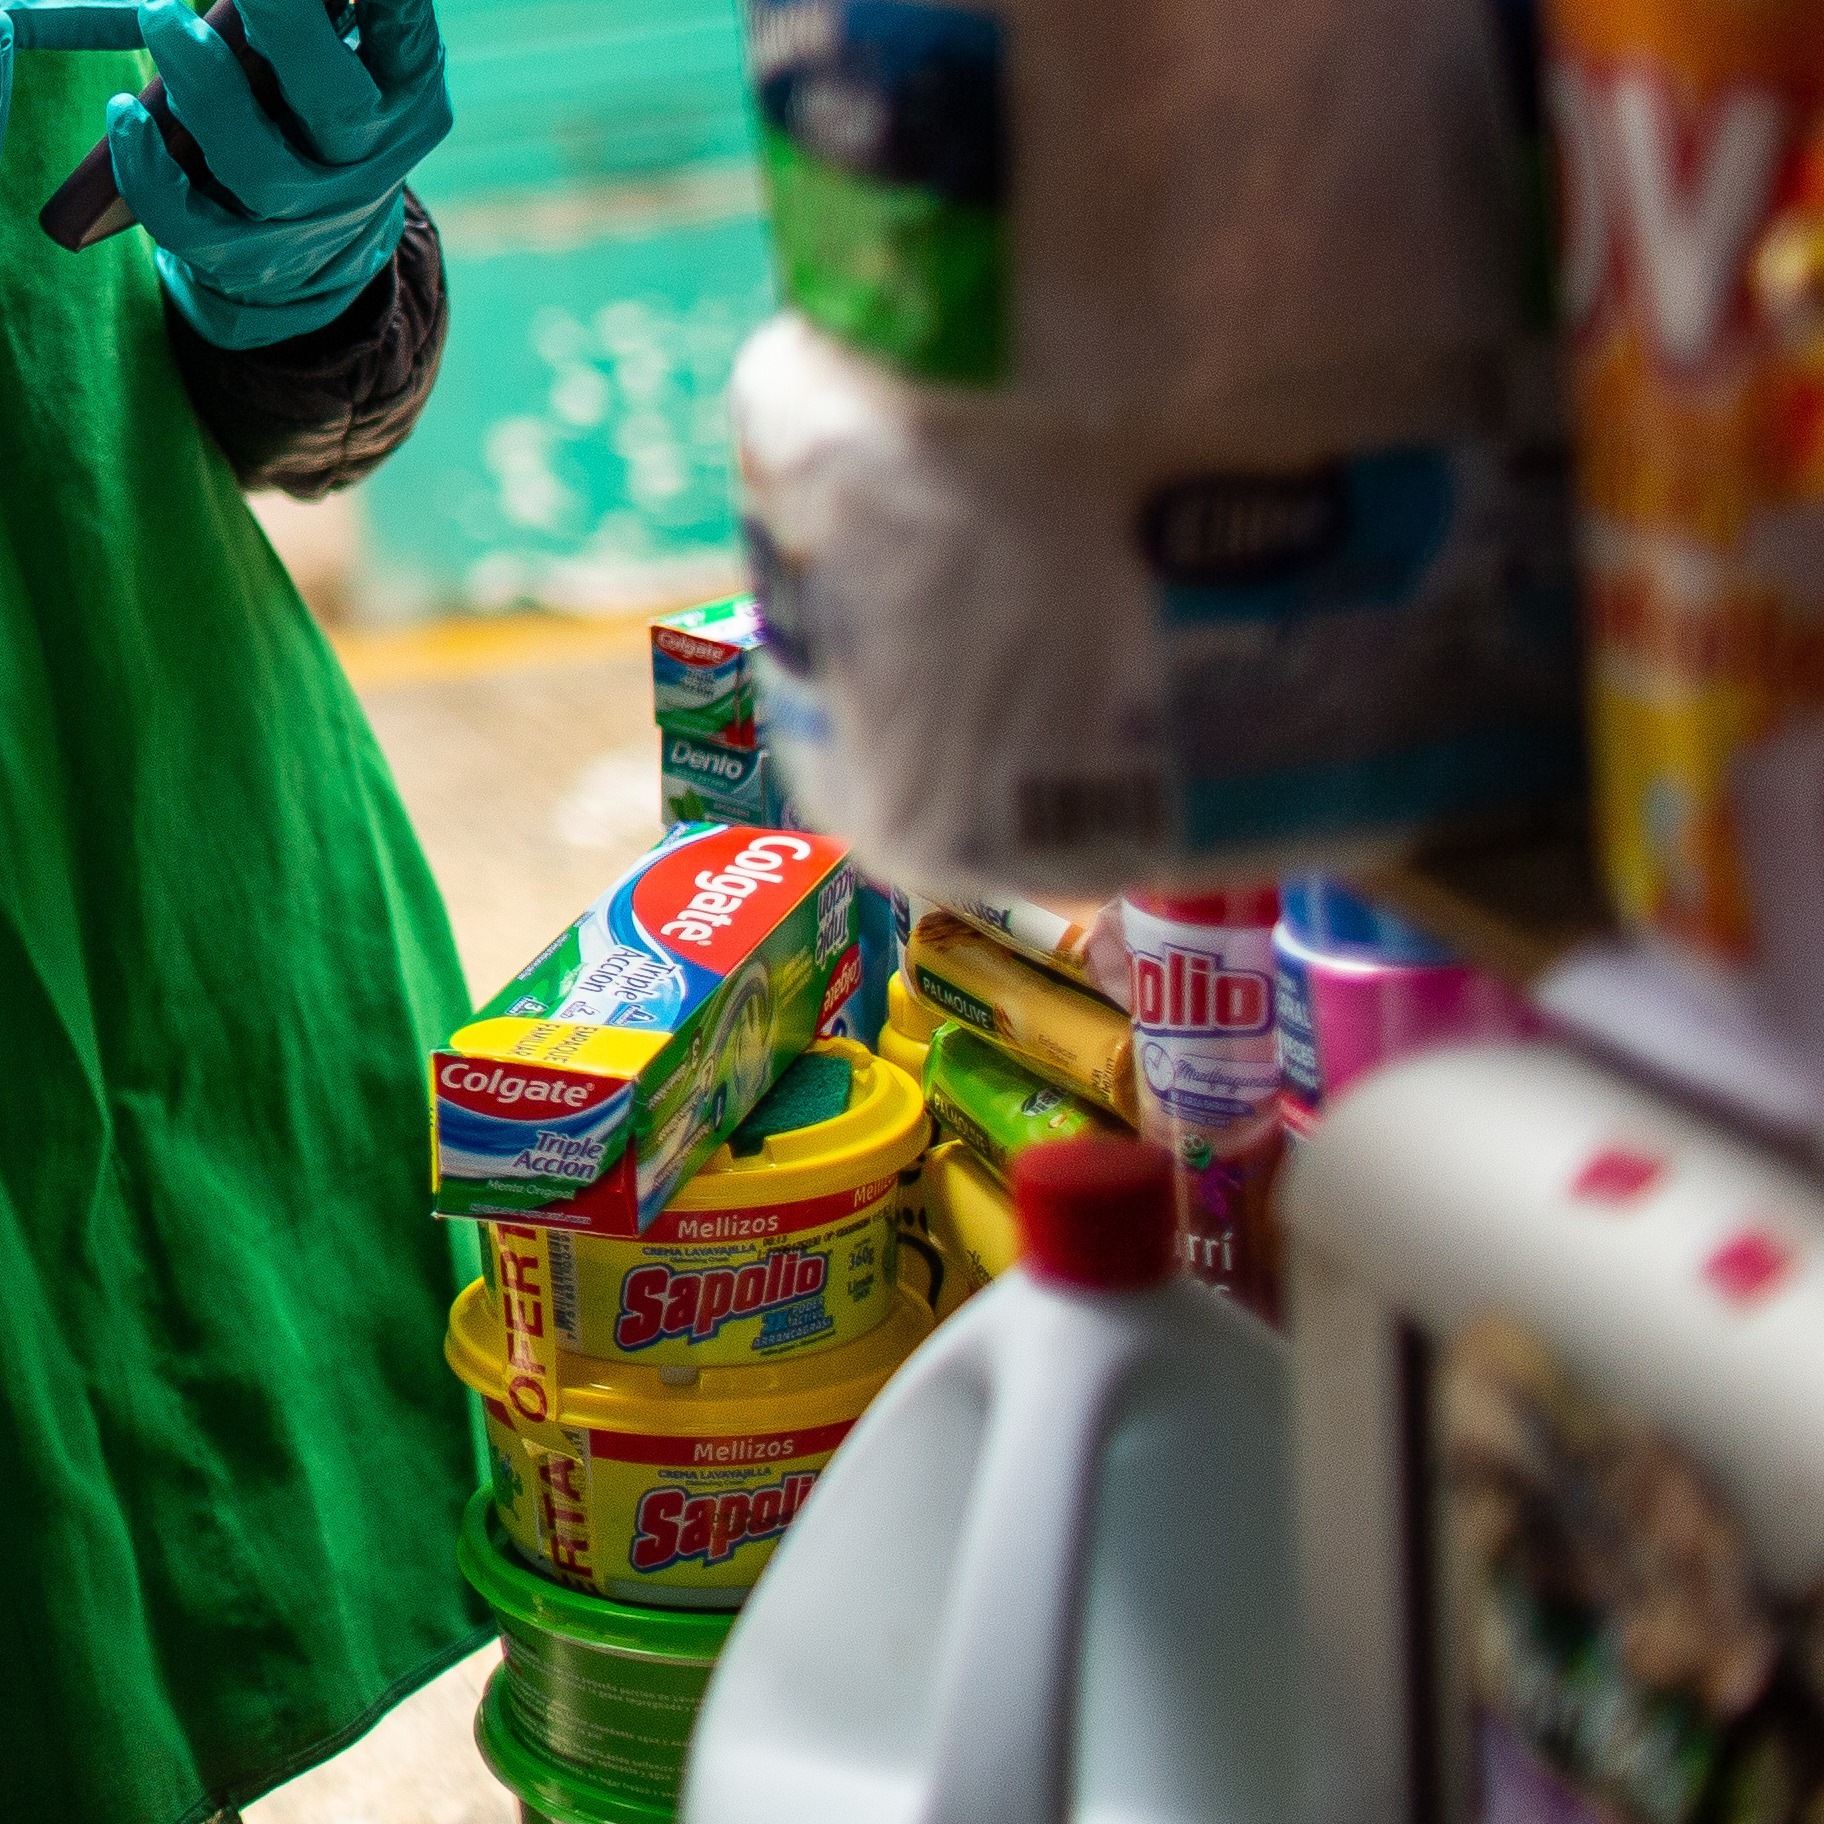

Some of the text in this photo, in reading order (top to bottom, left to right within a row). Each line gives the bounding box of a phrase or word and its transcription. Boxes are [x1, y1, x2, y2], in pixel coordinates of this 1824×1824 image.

[658, 630, 726, 664] Colgate
[660, 835, 811, 942] Colgate
[615, 962, 677, 1002] Triple
[923, 976, 990, 1029] PALMOLIVE
[1126, 948, 1269, 1029] olio
[440, 1062, 589, 1107] Colgate
[513, 1151, 596, 1180] Acción
[536, 1131, 602, 1160] Triple
[678, 1214, 780, 1239] Mellizos
[615, 1250, 829, 1352] Sapolio
[500, 1224, 549, 1424] OFERT
[693, 1439, 794, 1462] Mellizos
